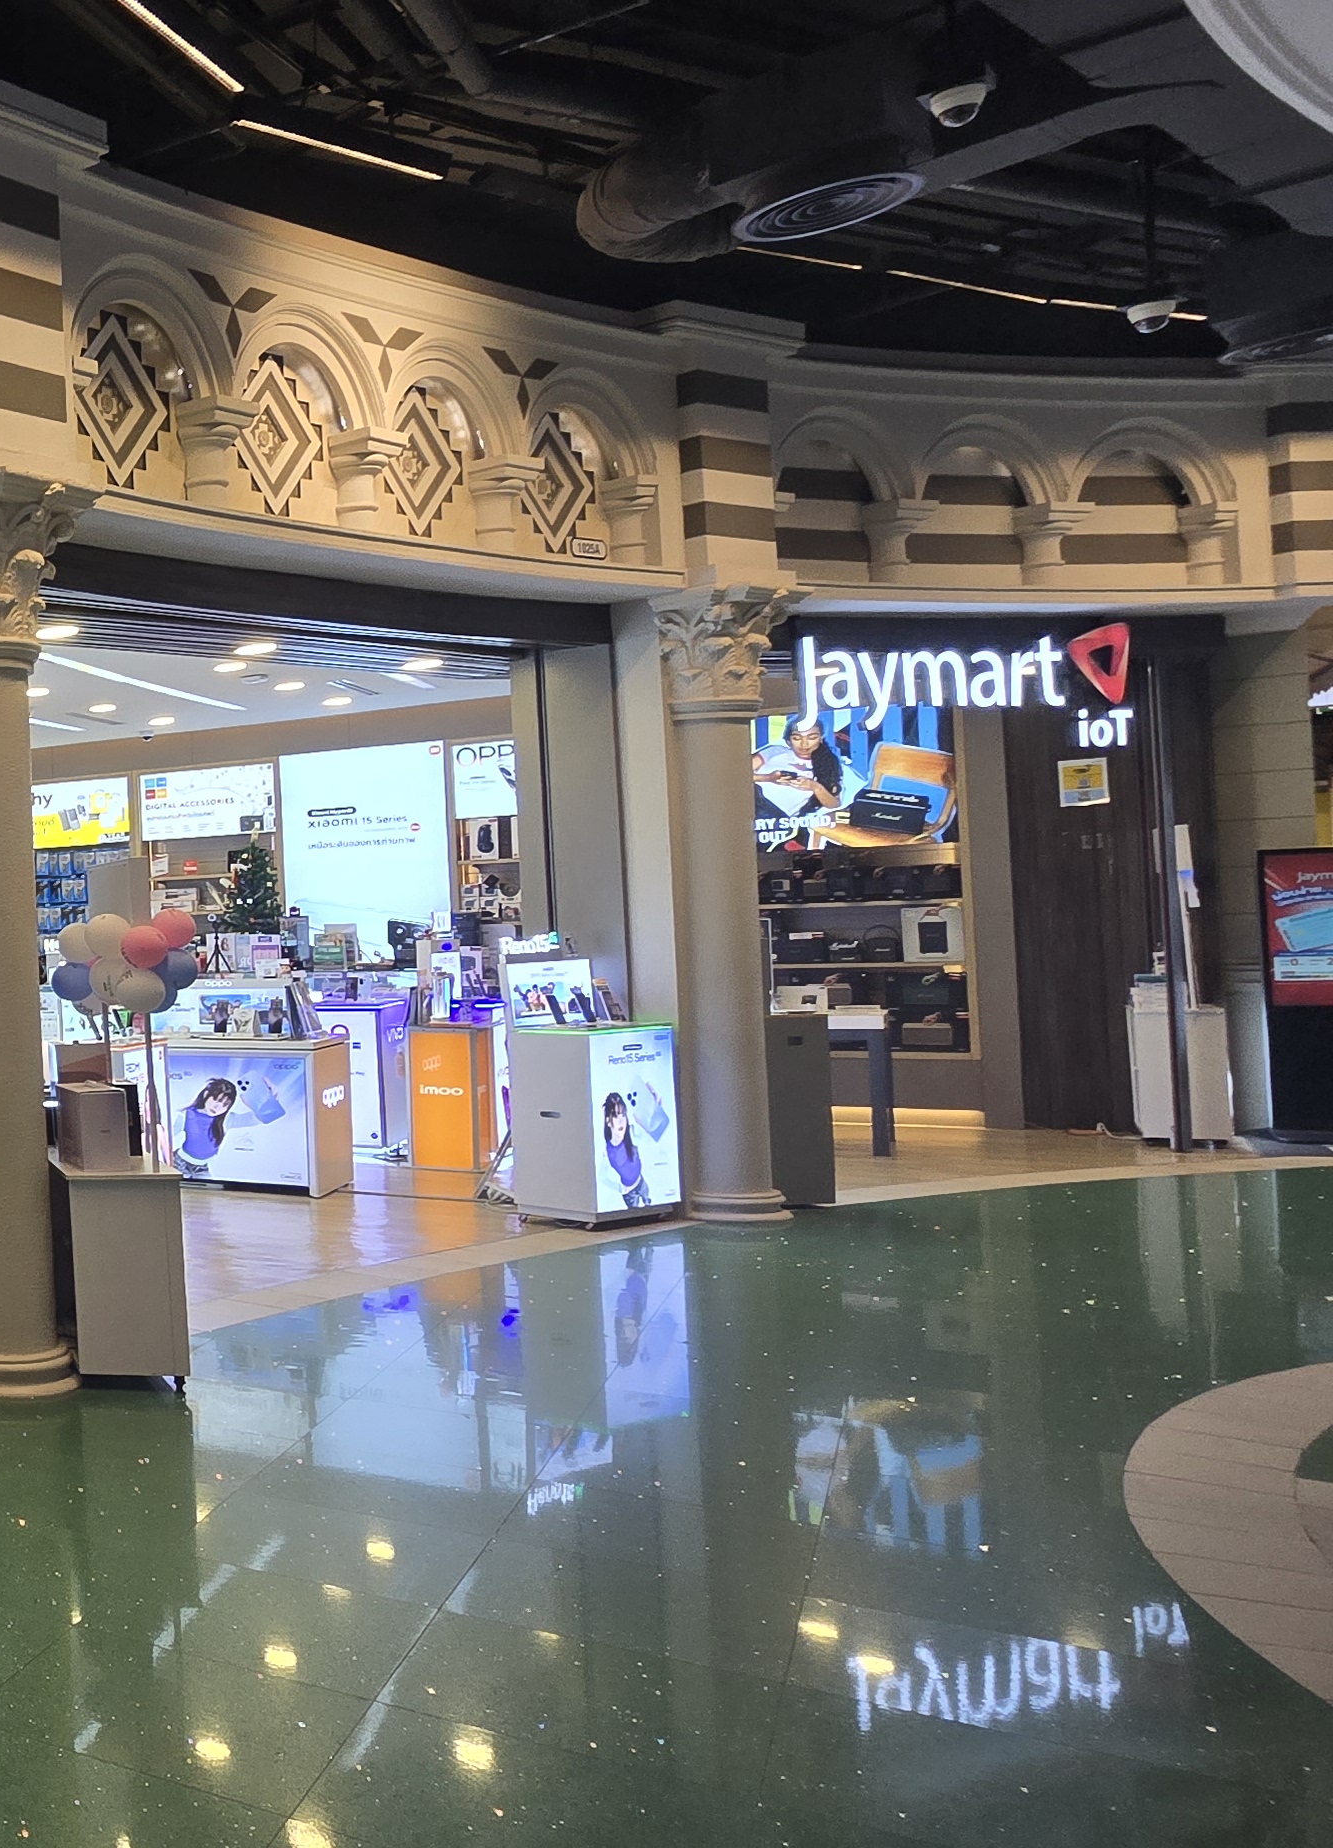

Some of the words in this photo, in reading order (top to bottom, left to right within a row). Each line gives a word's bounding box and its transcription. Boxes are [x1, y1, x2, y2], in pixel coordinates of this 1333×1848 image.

[798, 636, 1066, 731] Jaymart
[1077, 708, 1133, 748] ioT
[376, 815, 408, 824] Series
[754, 817, 776, 831] RY
[419, 1084, 464, 1096] imoo
